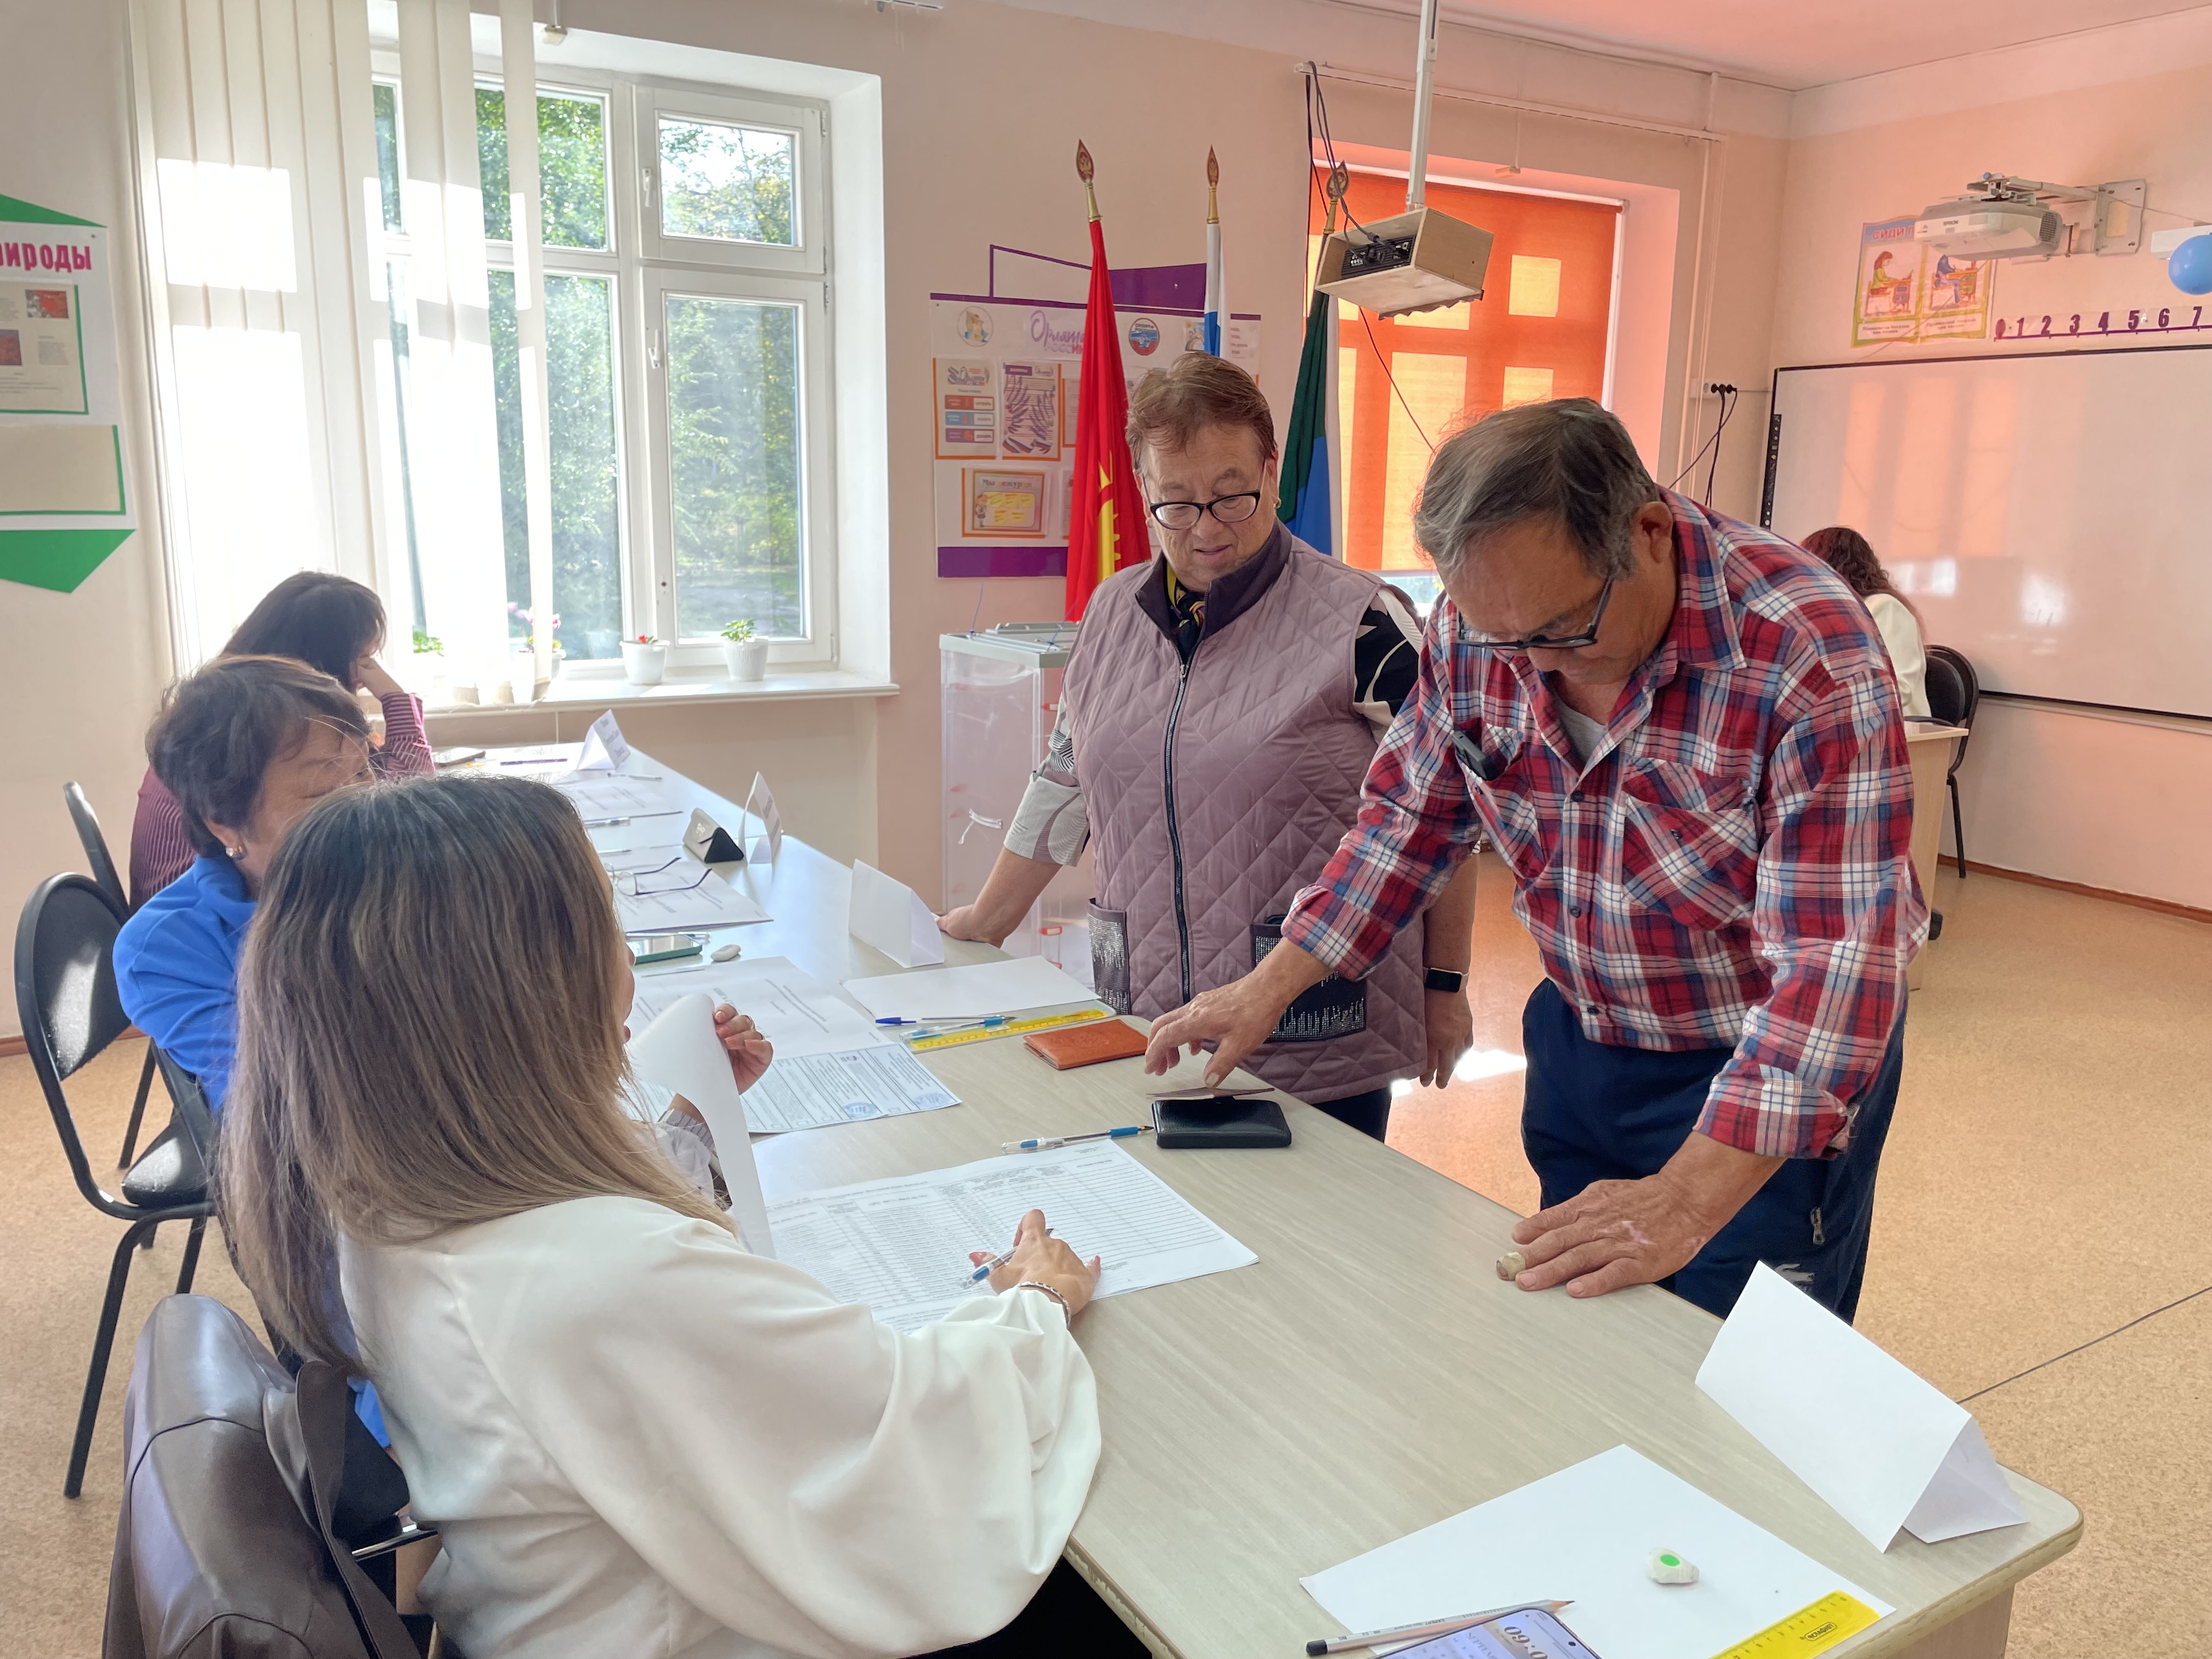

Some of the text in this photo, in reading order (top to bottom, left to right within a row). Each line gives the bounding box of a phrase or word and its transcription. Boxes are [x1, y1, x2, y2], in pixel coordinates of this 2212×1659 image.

[1872, 228, 1905, 240] СИДИ
[0, 242, 92, 273] ироды
[2016, 317, 2024, 336] 1
[2041, 315, 2051, 335] 2
[2069, 314, 2080, 334] 3
[2098, 312, 2109, 332] 4
[2128, 310, 2140, 330] 5
[2158, 308, 2170, 328] 6
[2192, 306, 2202, 326] 7
